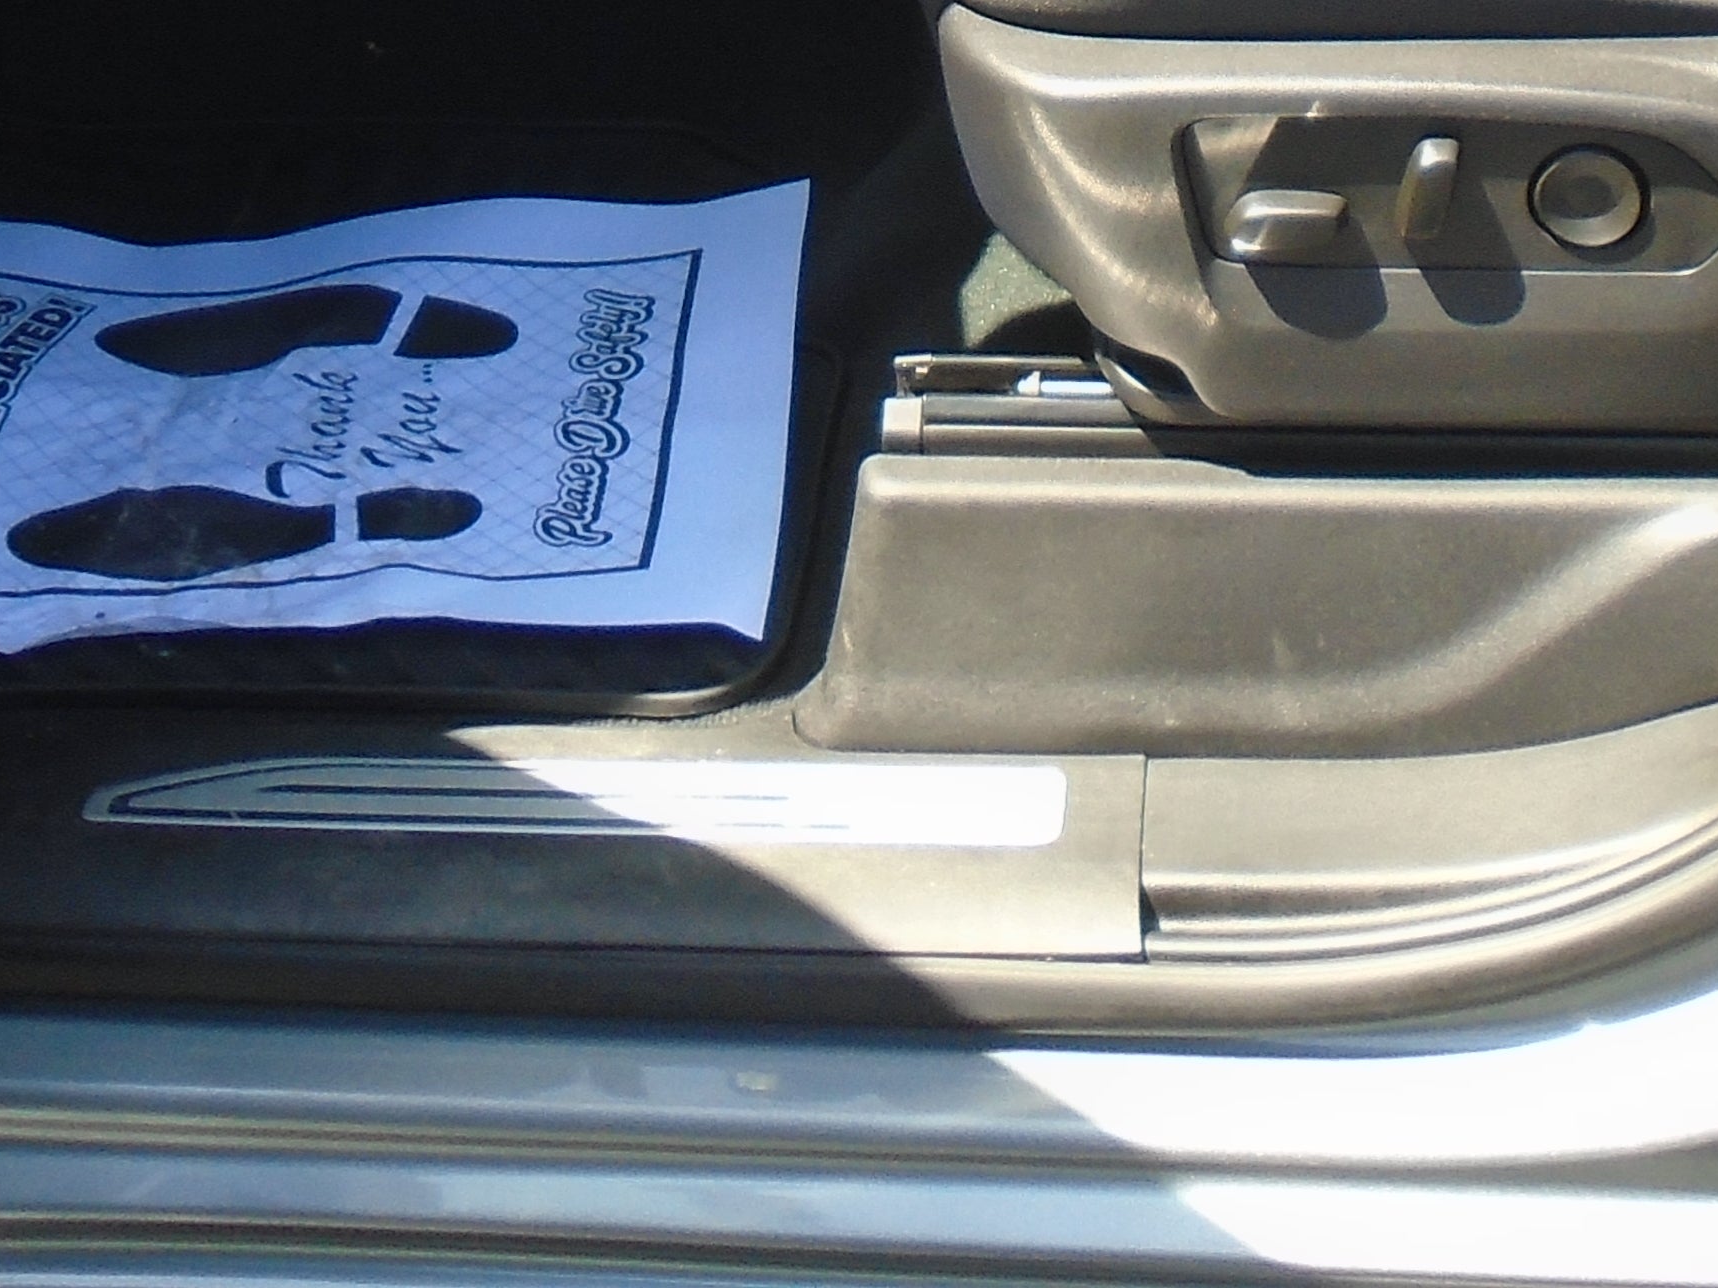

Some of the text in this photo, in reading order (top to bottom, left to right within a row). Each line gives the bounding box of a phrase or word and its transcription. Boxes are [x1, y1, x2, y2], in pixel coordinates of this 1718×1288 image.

[265, 372, 359, 499] Thank
[553, 379, 631, 460] Drive
[534, 454, 613, 548] Please
